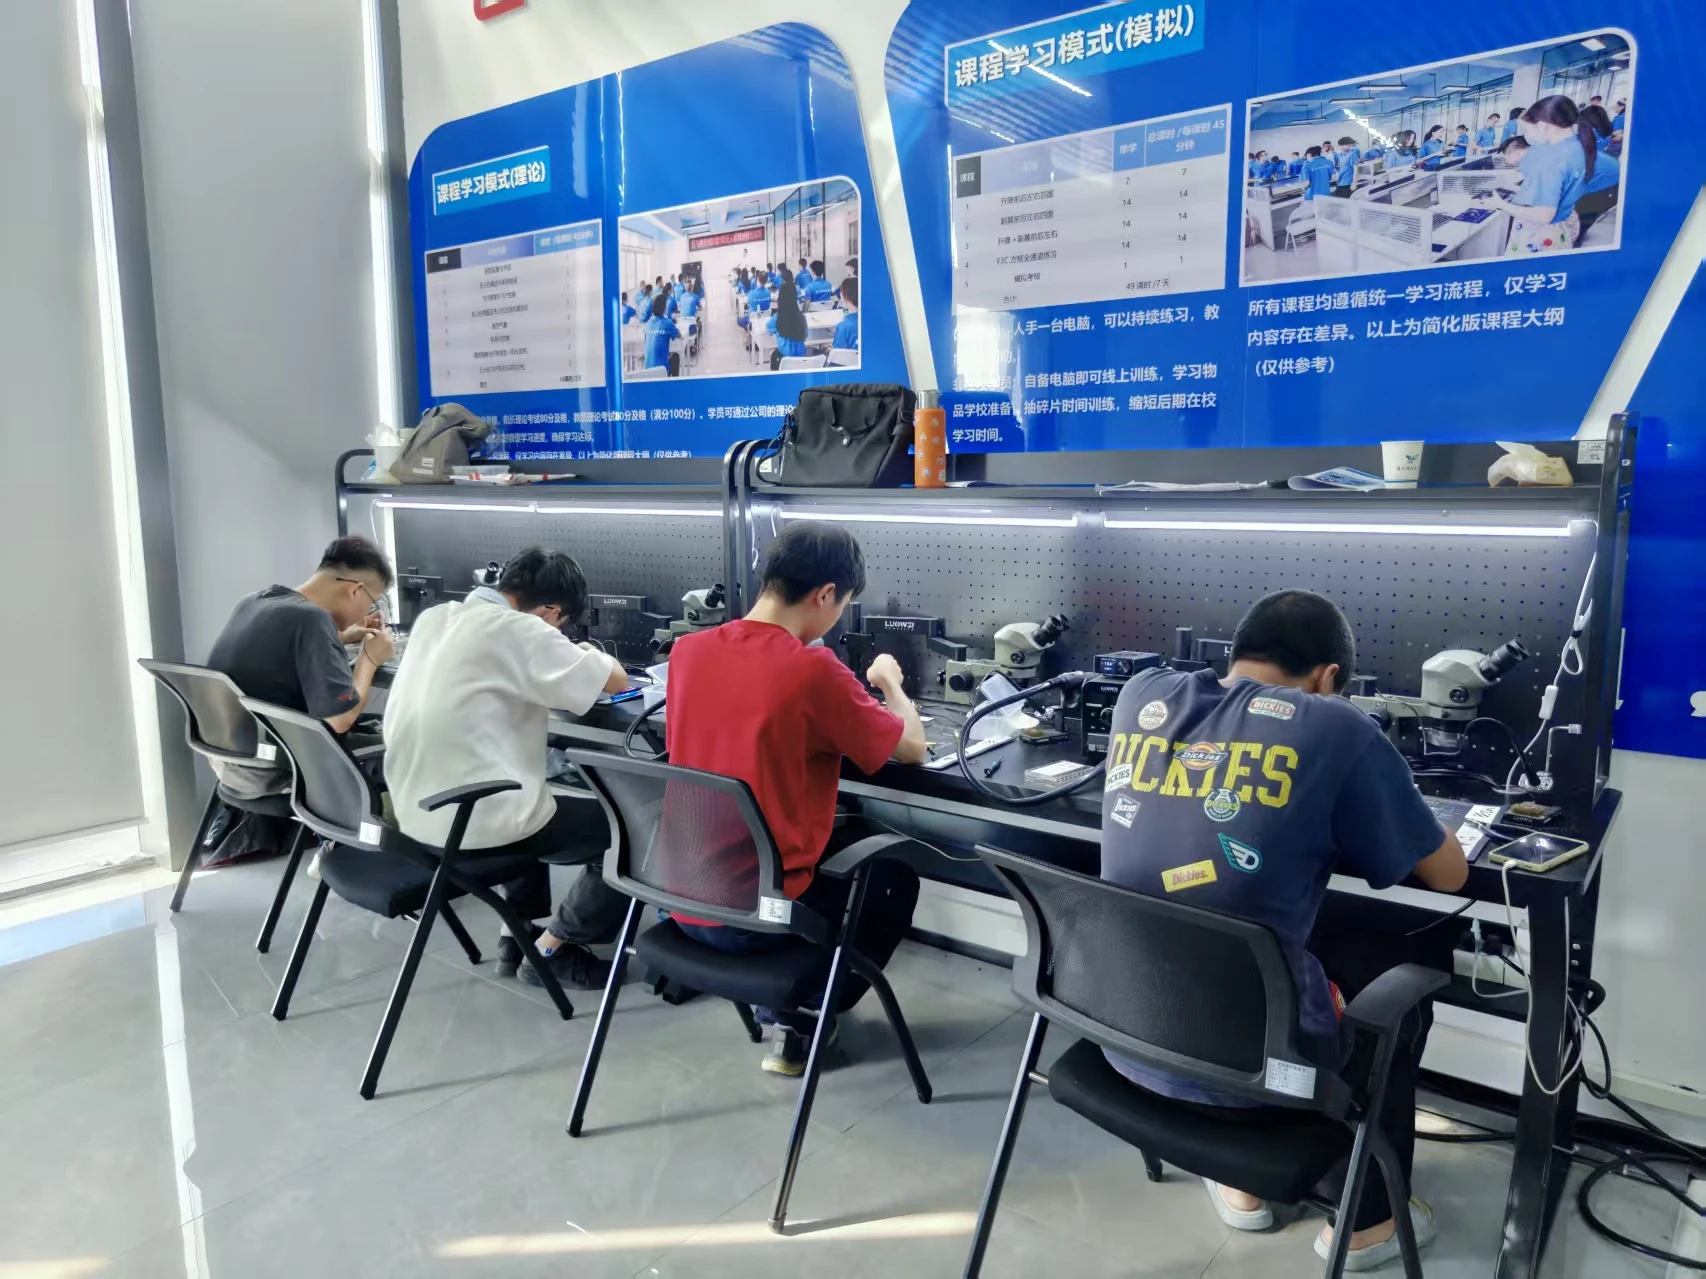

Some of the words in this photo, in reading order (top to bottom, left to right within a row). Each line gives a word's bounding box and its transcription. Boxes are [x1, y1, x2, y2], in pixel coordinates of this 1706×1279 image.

[955, 4, 1194, 87] 课程学习模式(模拟)
[437, 161, 546, 204] 课程学习模式(理论)
[1179, 190, 1188, 198] 14
[1179, 212, 1187, 220] 14
[1122, 220, 1131, 228] 14
[1122, 241, 1130, 249] 14
[1248, 273, 1568, 316] 所有课程均遵循统一学习流程，仅学习
[1247, 307, 1565, 347] 内容存在差异。以上为简化版课程大纲
[1255, 357, 1335, 377] （仅供参考）
[953, 428, 1003, 443] 学习时间。
[1254, 701, 1291, 714] DICKIES
[1180, 751, 1221, 761] Dickies
